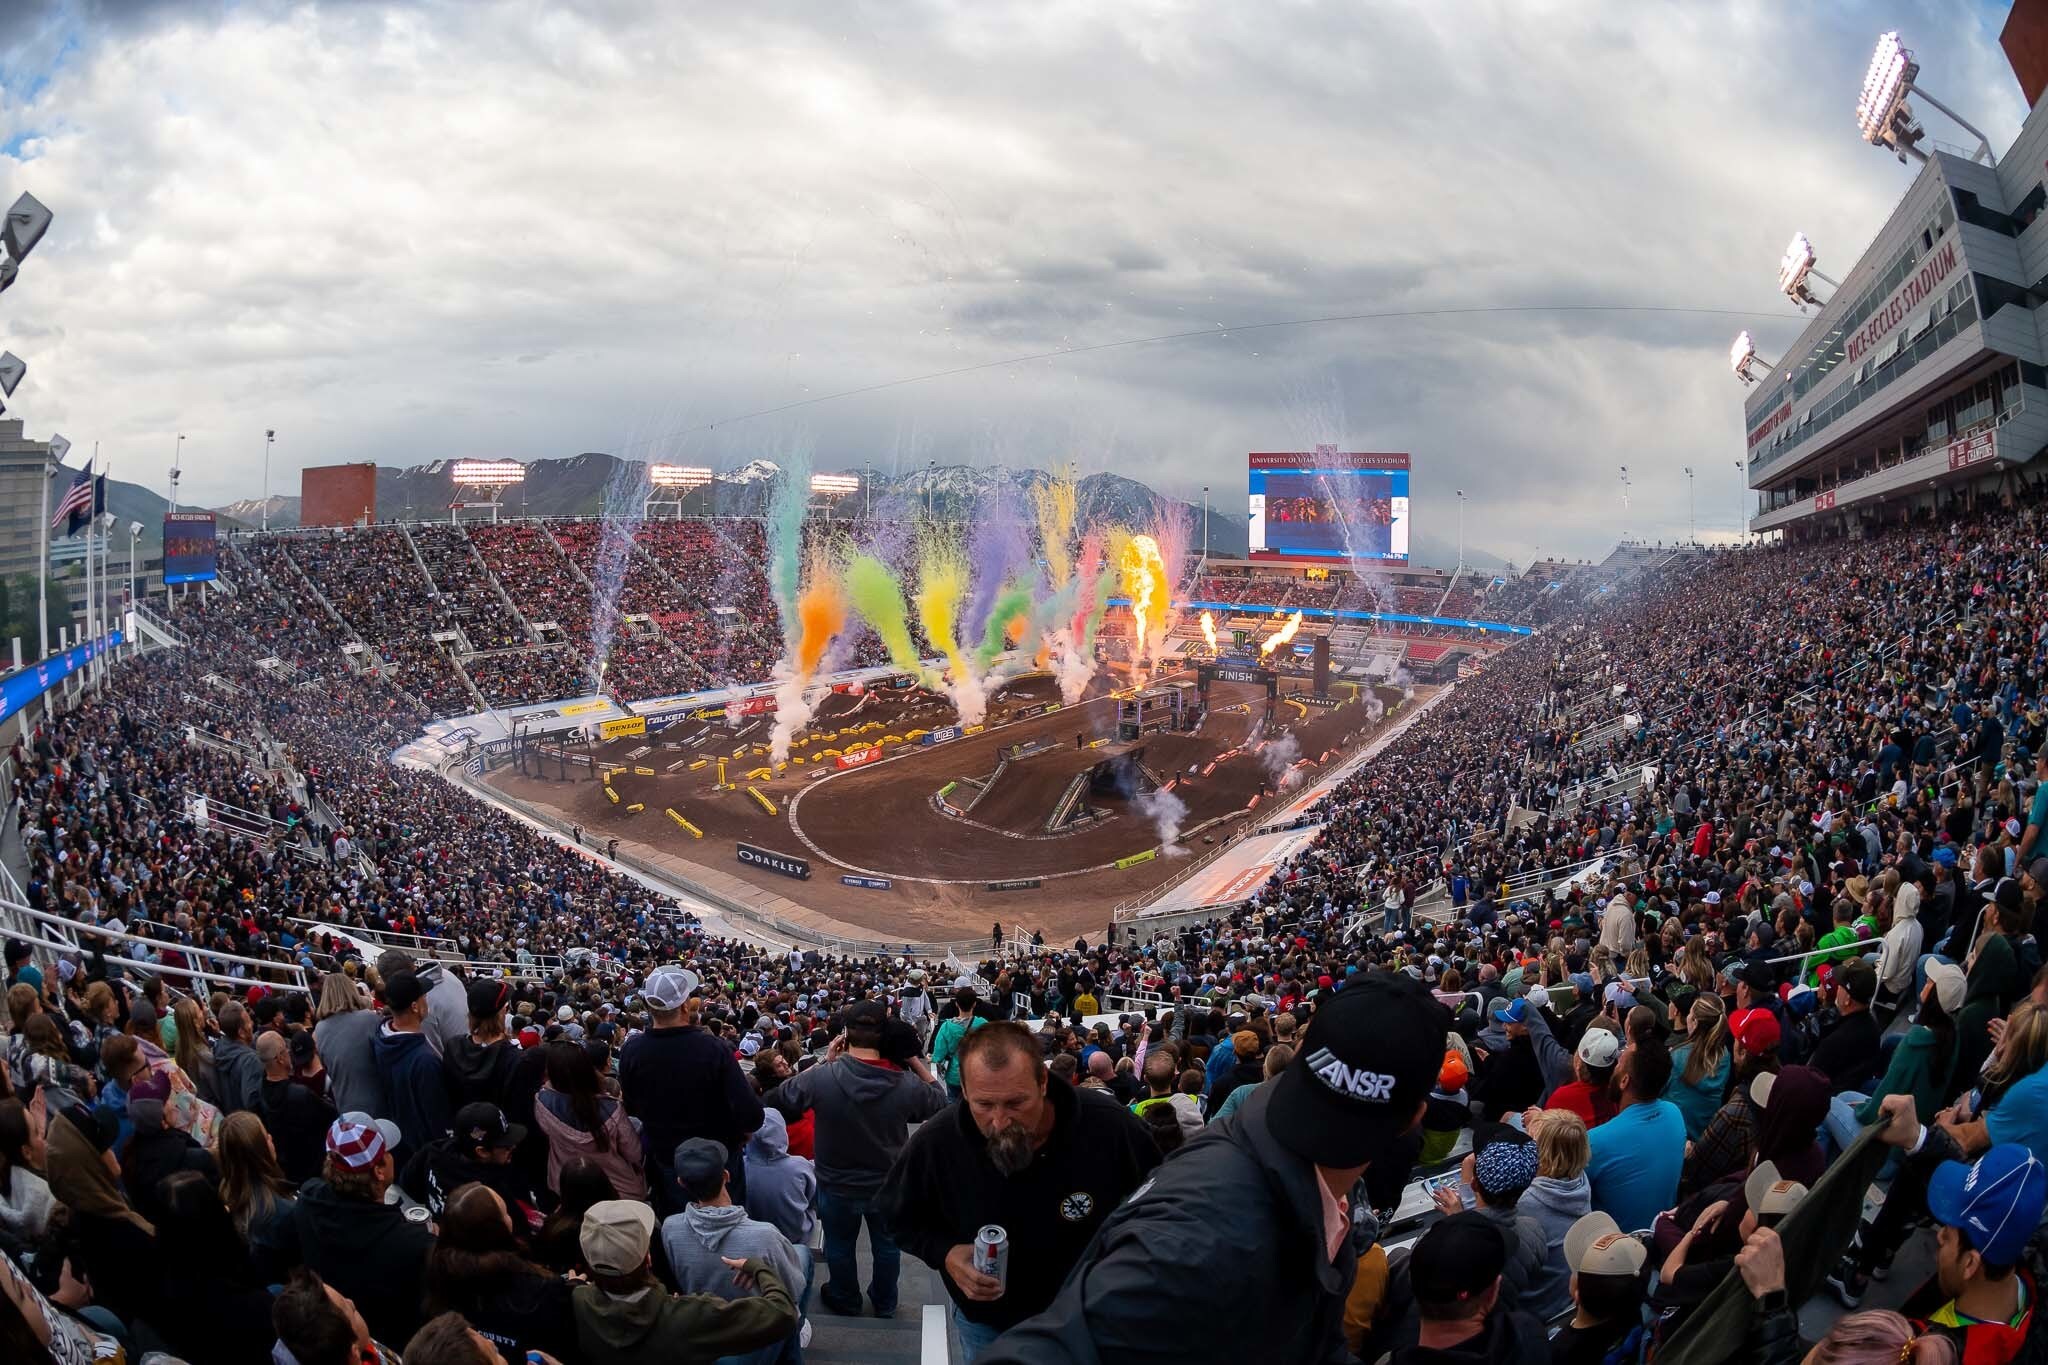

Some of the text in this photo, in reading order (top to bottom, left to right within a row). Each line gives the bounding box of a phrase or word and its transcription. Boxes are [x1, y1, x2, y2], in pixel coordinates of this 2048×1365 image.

[1848, 241, 1957, 364] RICE-ECCLES STADIUM
[1218, 670, 1253, 682] FINISH
[1305, 698, 1335, 706] OAKLEY
[647, 712, 686, 725] FALKEN
[609, 721, 644, 733] DUNLOP
[841, 749, 869, 766] FLY
[754, 854, 803, 874] OAKLEY
[1318, 1058, 1396, 1100] ANSR
